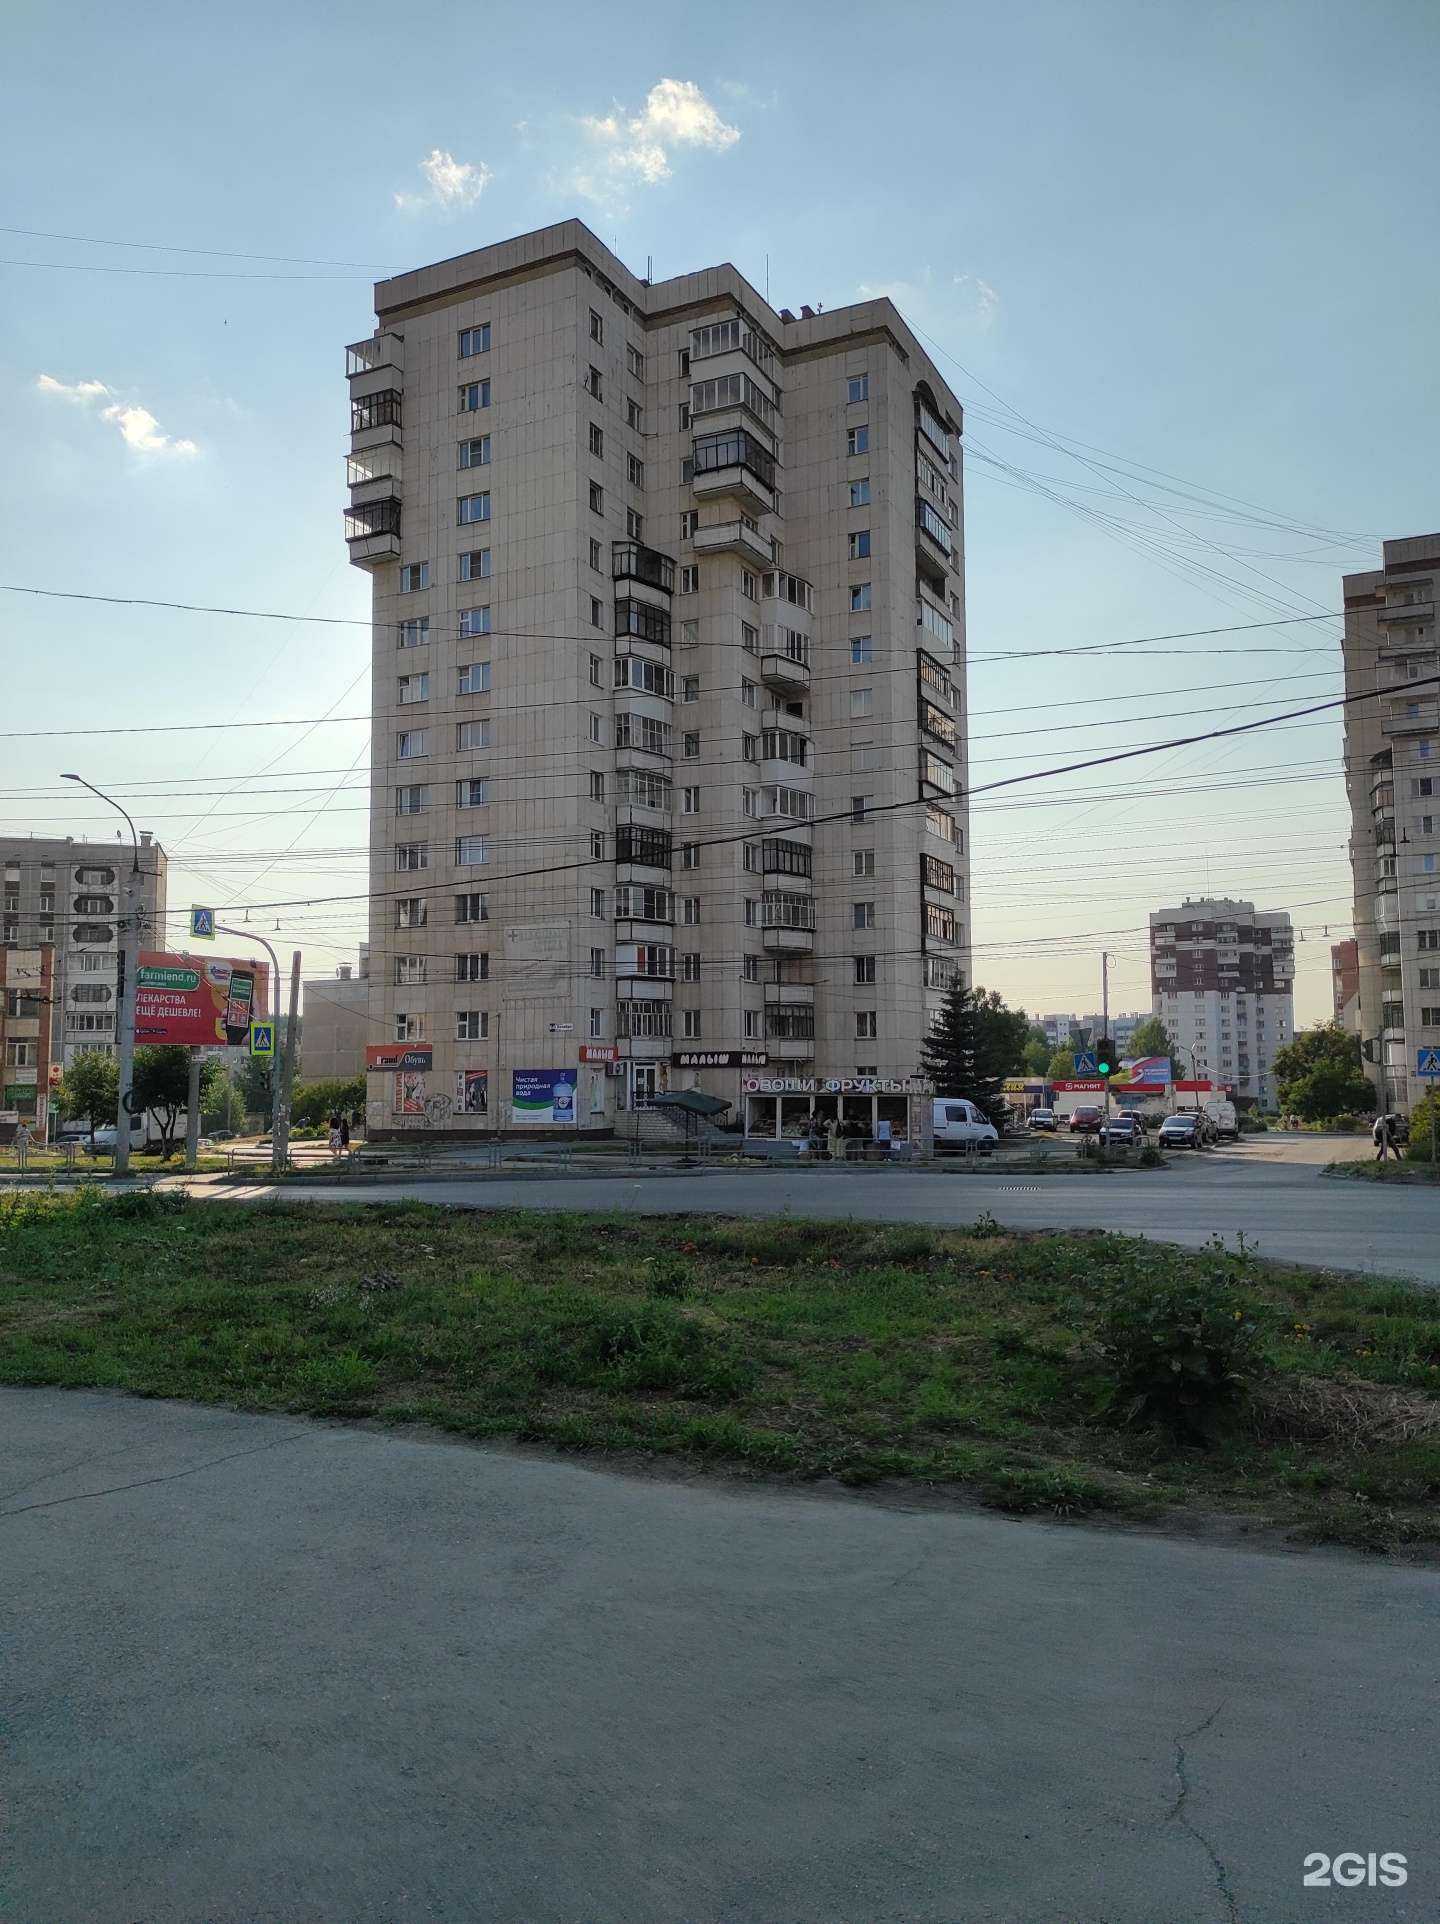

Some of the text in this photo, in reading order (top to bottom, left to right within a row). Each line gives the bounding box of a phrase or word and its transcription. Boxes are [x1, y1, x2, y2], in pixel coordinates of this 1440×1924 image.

[140, 970, 197, 983] farmlend.ru
[136, 993, 186, 1004] ЛЕКАРСТВА
[157, 1007, 201, 1018] ДЕШЕВЛЕ!
[680, 1054, 730, 1065] МАЛЫШ
[515, 1083, 551, 1091] природная
[747, 1078, 815, 1092] ОВОЩИ
[825, 1078, 910, 1093] ФРУКТЫ
